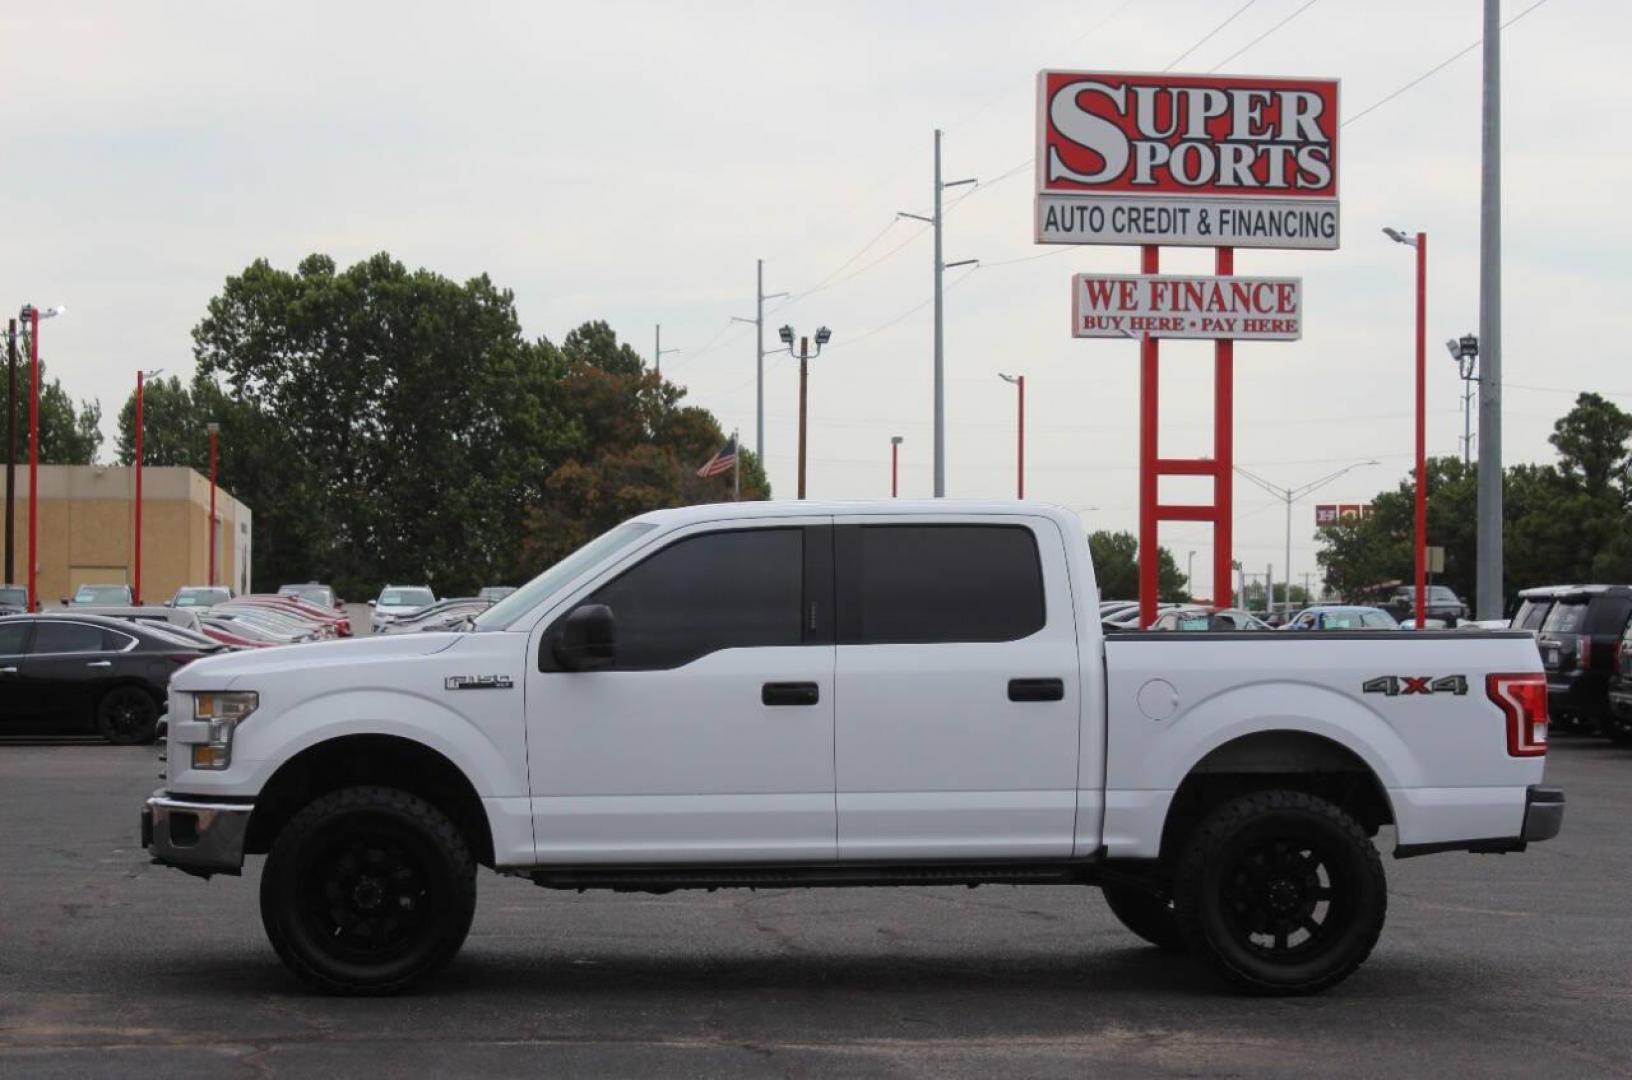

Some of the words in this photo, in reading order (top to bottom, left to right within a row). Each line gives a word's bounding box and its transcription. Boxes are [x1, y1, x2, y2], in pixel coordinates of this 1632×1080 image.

[1051, 81, 1329, 184] SUPER
[1044, 205, 1105, 233] AUTO
[1111, 207, 1191, 236] CREDIT
[1196, 209, 1212, 236] &
[1218, 209, 1336, 239] FINANCING
[1084, 279, 1139, 311] WE
[1148, 281, 1297, 314] FINANCE
[1083, 315, 1125, 330] BUY
[1129, 316, 1185, 332] HERE
[1201, 317, 1238, 333] PAY
[1242, 318, 1298, 333] HERE
